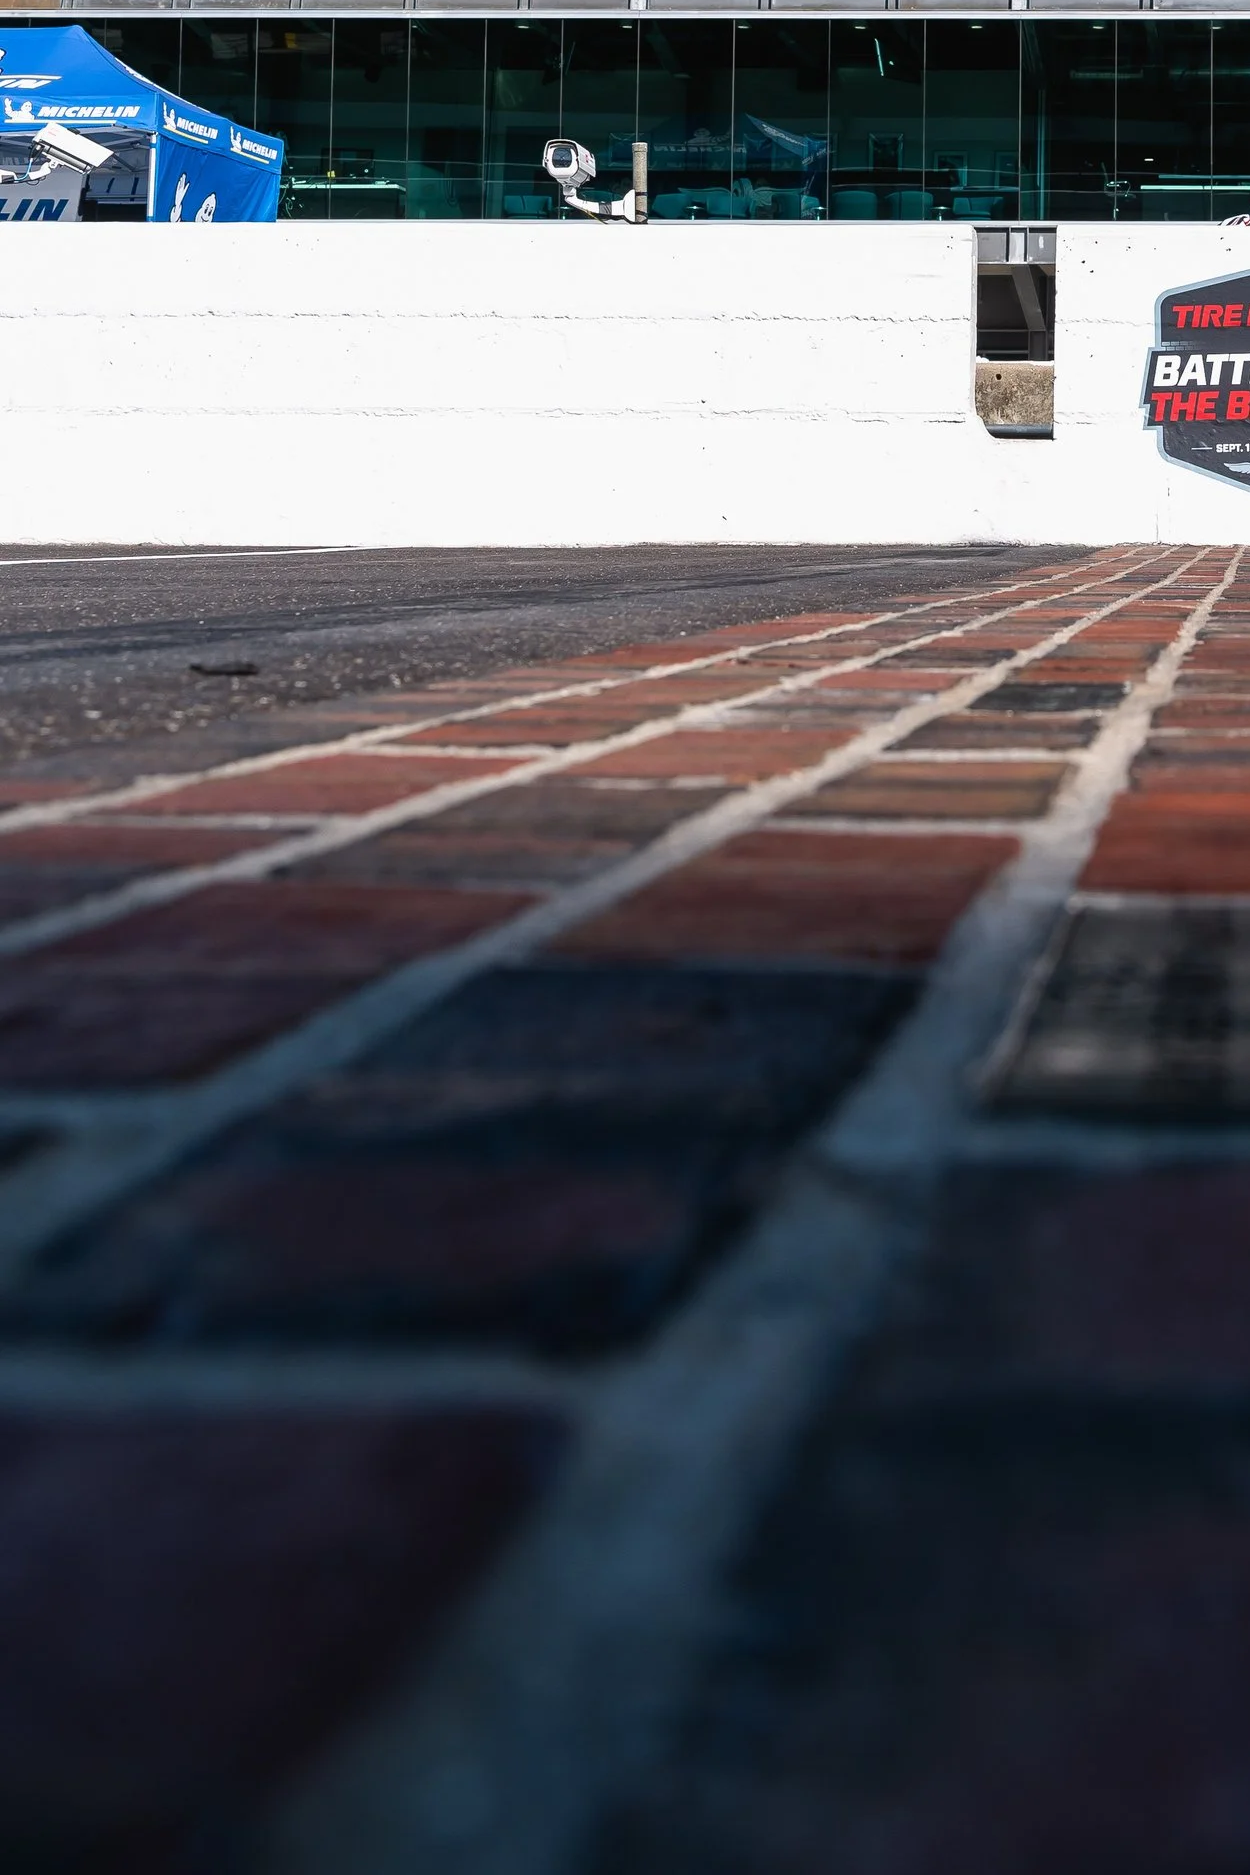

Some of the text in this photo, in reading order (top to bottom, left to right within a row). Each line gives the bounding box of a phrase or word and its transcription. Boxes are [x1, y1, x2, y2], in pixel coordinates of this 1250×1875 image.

[37, 106, 141, 118] MICHELIN
[176, 117, 219, 140] MICHELIN
[242, 139, 278, 160] MICHELIN
[1172, 303, 1243, 329] TIRE
[1151, 391, 1220, 422] THE
[1215, 443, 1244, 453] SEPT.
